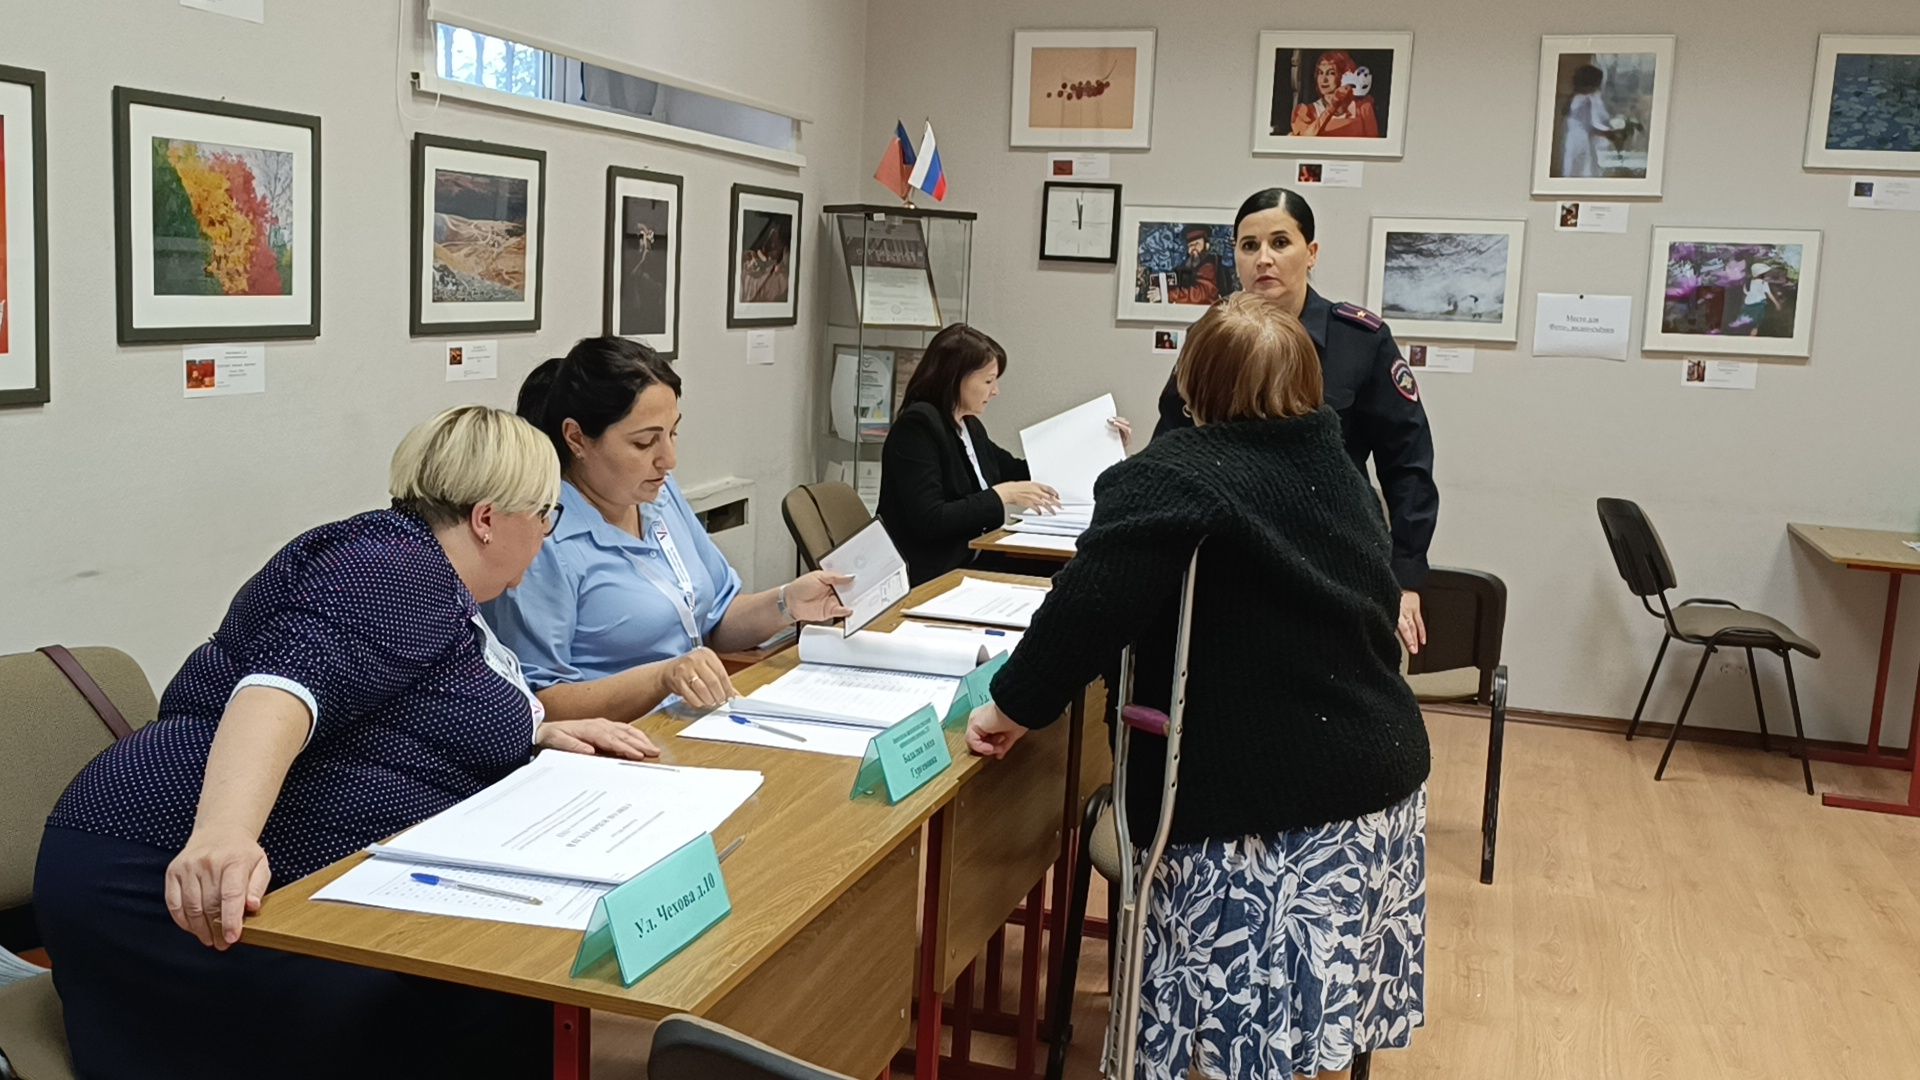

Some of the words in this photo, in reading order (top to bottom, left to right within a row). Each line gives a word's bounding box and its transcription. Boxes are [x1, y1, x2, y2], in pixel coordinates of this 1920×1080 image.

[634, 918, 658, 939] Ул.
[656, 890, 696, 921] Чехова
[697, 872, 716, 901] д.10
